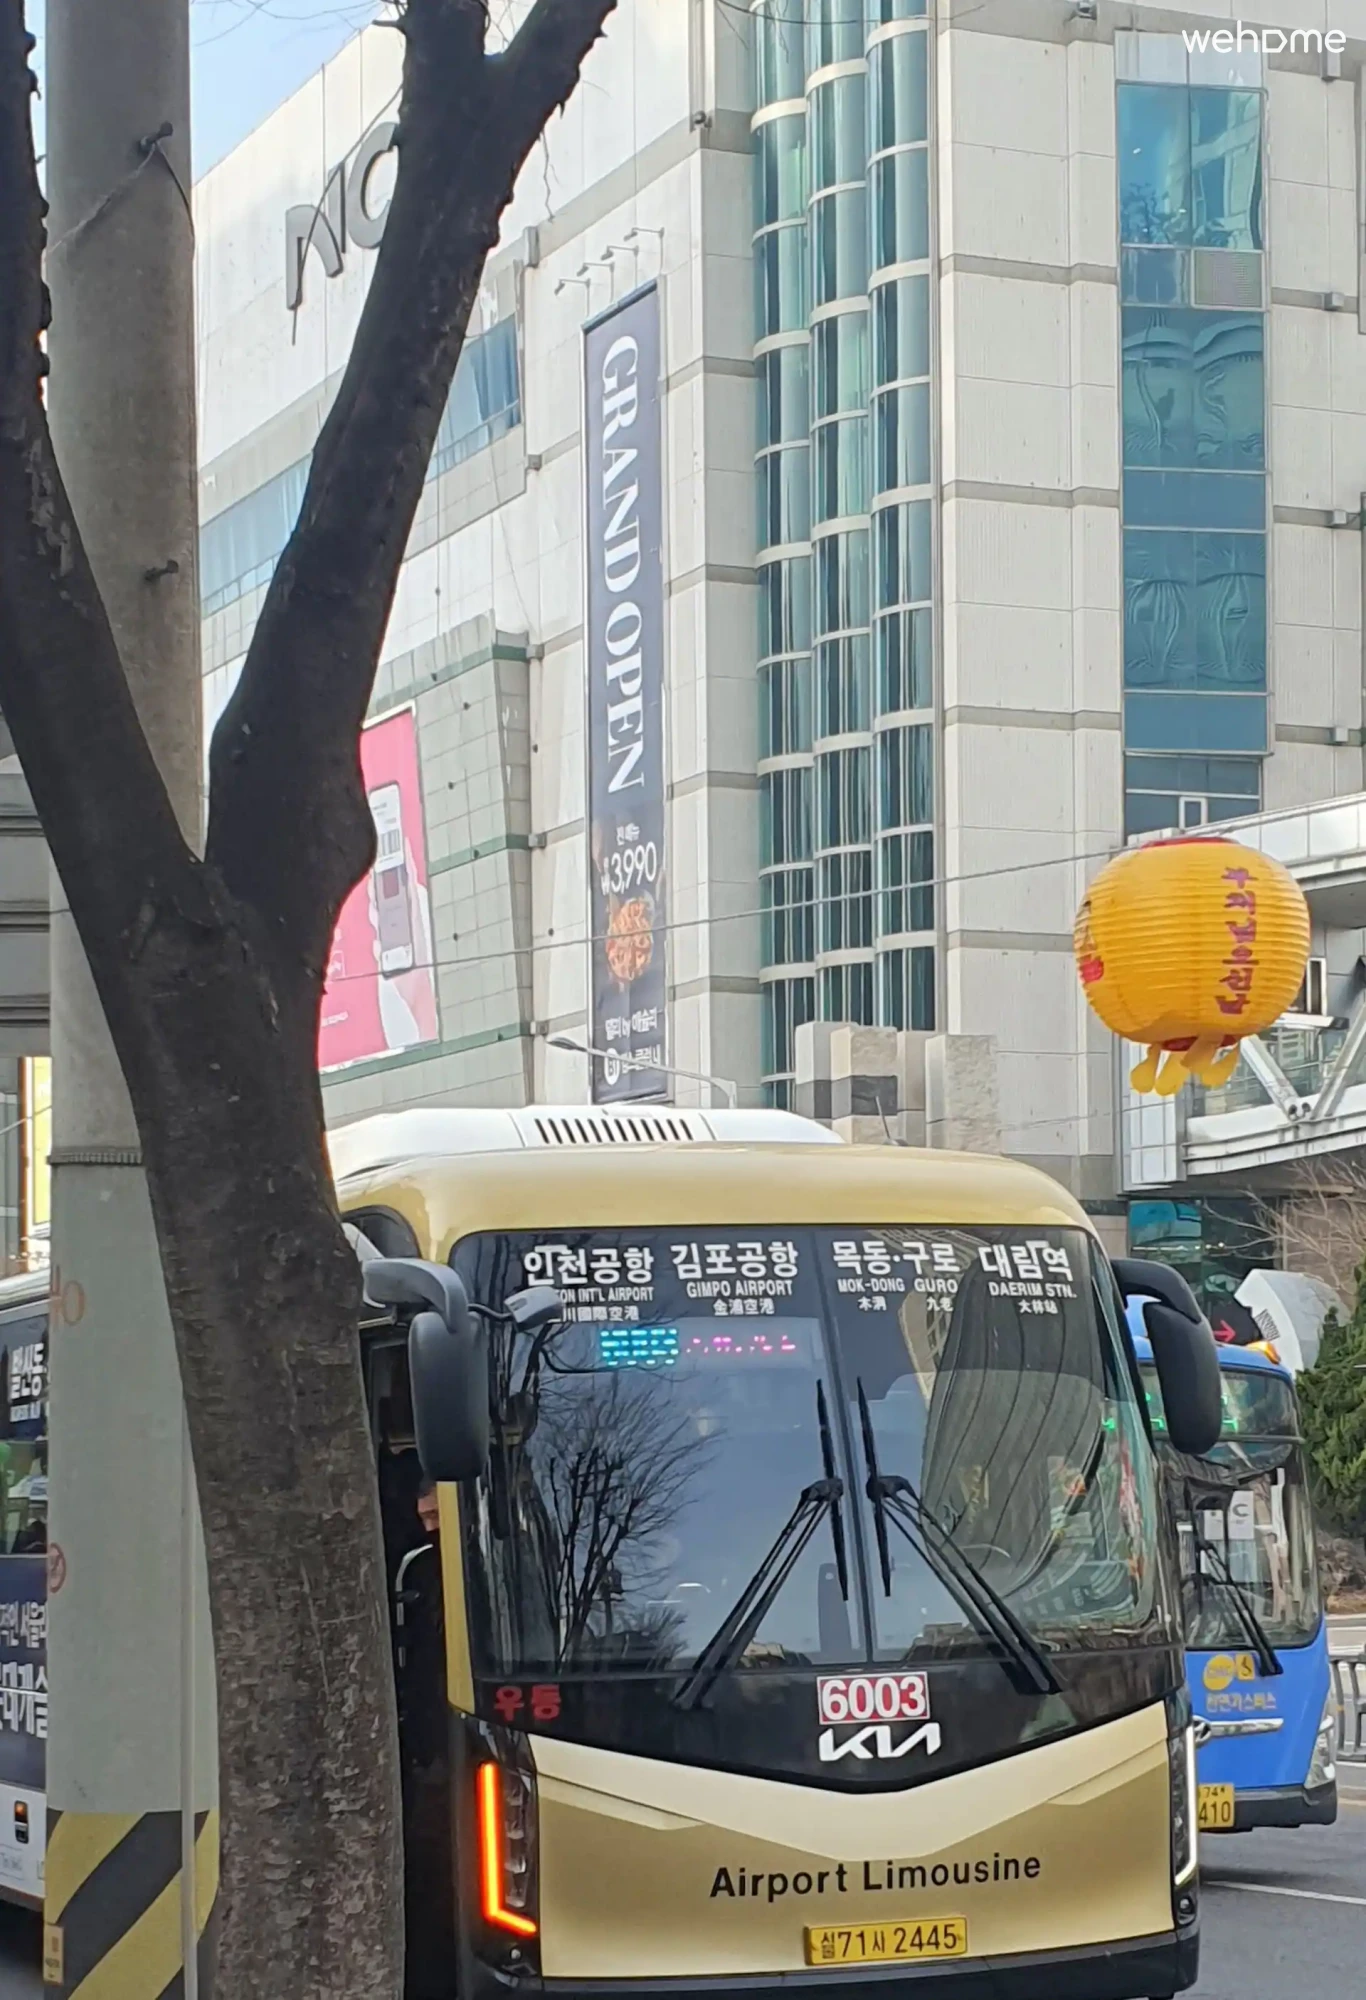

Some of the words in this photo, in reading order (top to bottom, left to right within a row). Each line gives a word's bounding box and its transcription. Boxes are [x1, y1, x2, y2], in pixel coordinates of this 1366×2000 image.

[602, 335, 640, 594] GRAND
[605, 601, 645, 794] OPEN
[524, 1246, 654, 1286] 인천공항
[670, 1241, 799, 1280] 김포공항
[978, 1240, 1074, 1282] 대림역
[607, 1286, 654, 1302] AIRPORT
[686, 1280, 732, 1298] GIMPO
[735, 1279, 793, 1297] AIRPORT
[837, 1278, 906, 1293] MOK-DONG
[914, 1278, 959, 1294] GURO
[988, 1281, 1044, 1297] DAERIM
[547, 1304, 640, 1322] 川國際空港
[494, 1685, 562, 1721] 우등
[822, 1676, 926, 1720] 6003
[819, 1722, 941, 1761] KIA
[709, 1863, 848, 1903] Airport
[863, 1852, 1041, 1890] Limousine
[893, 1924, 957, 1954] 2445
